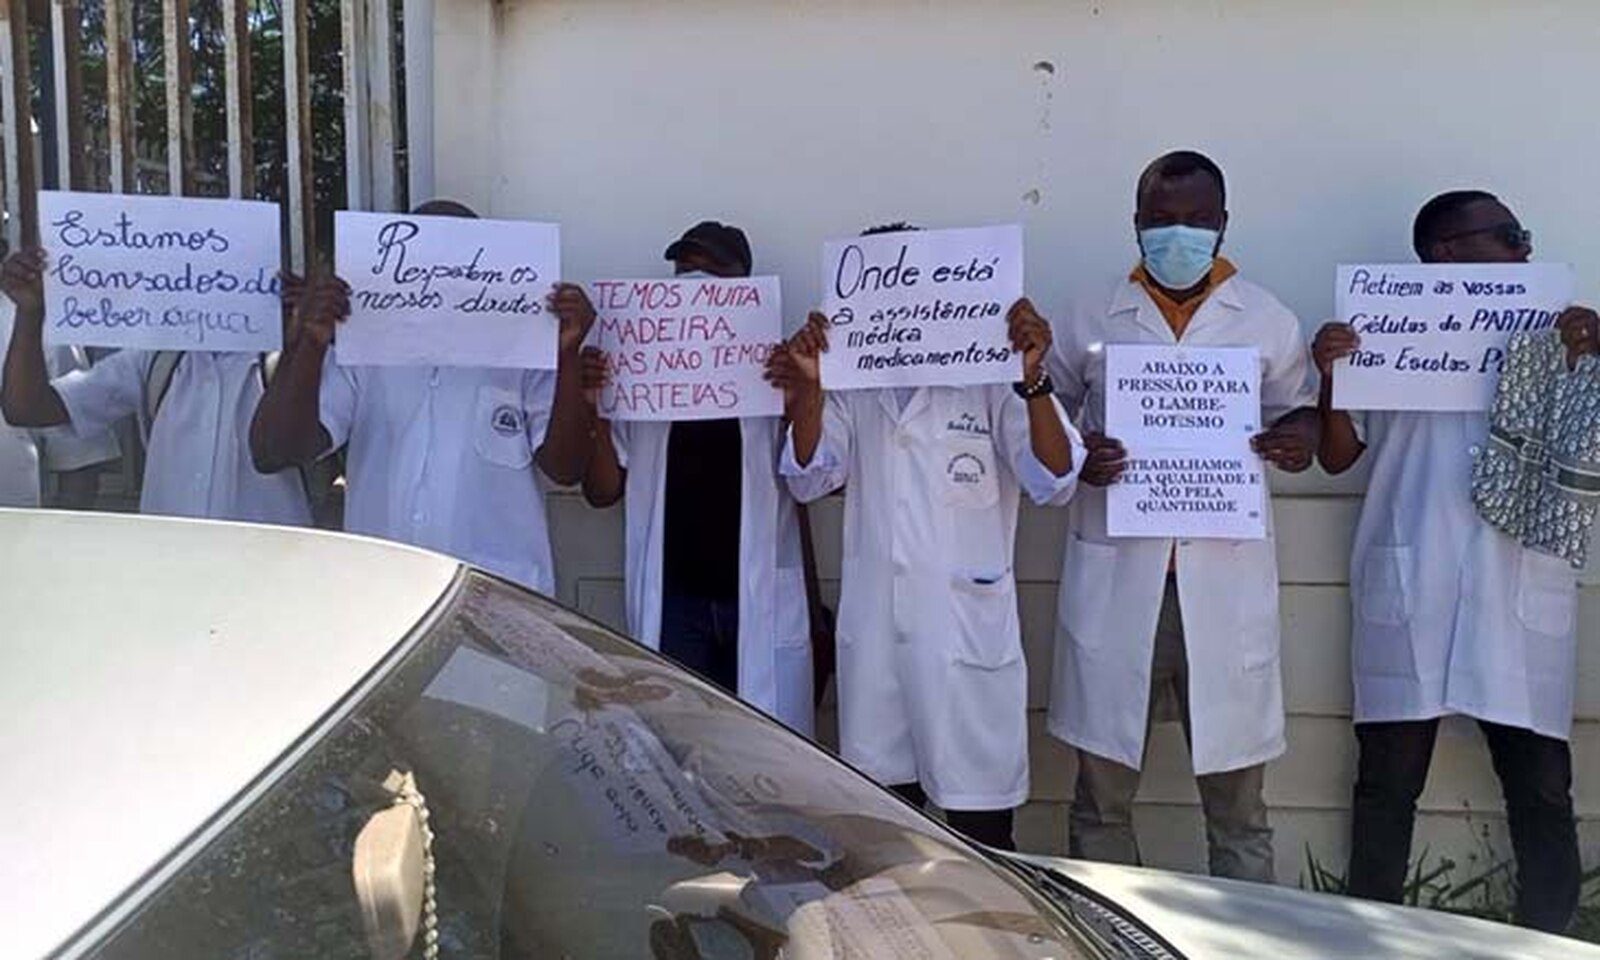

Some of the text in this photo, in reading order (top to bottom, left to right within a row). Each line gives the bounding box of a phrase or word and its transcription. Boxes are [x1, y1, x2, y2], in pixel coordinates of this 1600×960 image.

[52, 210, 229, 252] Estamos
[510, 266, 538, 285] os
[836, 244, 1000, 299] Onde está
[356, 288, 442, 310] nossos
[593, 281, 682, 310] TEMOS
[57, 296, 152, 328] beber
[870, 300, 1001, 322] assistência
[847, 322, 923, 348] médica
[655, 348, 702, 373] NÃO
[712, 342, 773, 368] TEMO
[857, 342, 1010, 371] medicamentosa
[1395, 347, 1470, 372] Escolas
[1142, 362, 1225, 376] ABAIXO A
[1118, 377, 1250, 394] PRESSÃO PARA
[1141, 397, 1227, 412] O LAMBE-
[1130, 459, 1242, 471] TRABALHAMOS
[1156, 473, 1246, 487] QUALIDADE
[1249, 473, 1260, 485] E
[1149, 486, 1224, 498] NÃO PELA
[1136, 500, 1238, 514] QUANTIDADE
